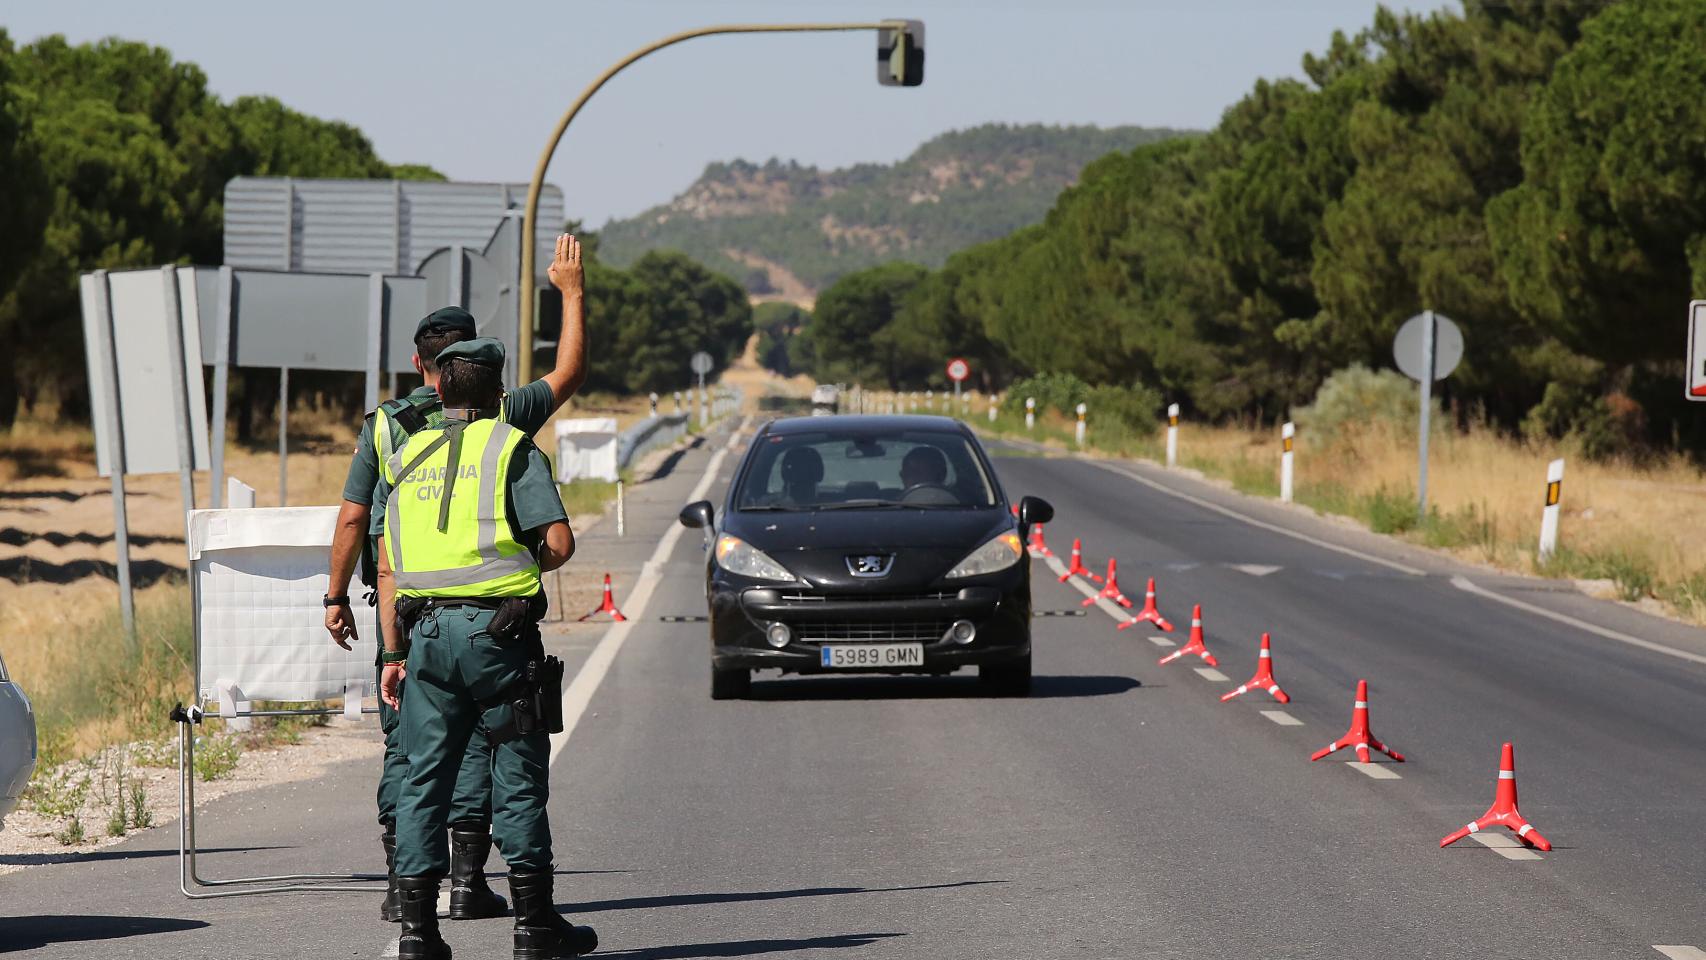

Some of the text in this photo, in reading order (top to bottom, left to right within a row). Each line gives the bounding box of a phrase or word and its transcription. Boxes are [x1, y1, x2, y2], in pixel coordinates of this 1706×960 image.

[404, 464, 478, 483] GUARIA
[416, 485, 457, 501] CIV
[835, 648, 879, 664] 5989
[886, 647, 918, 663] GMN
